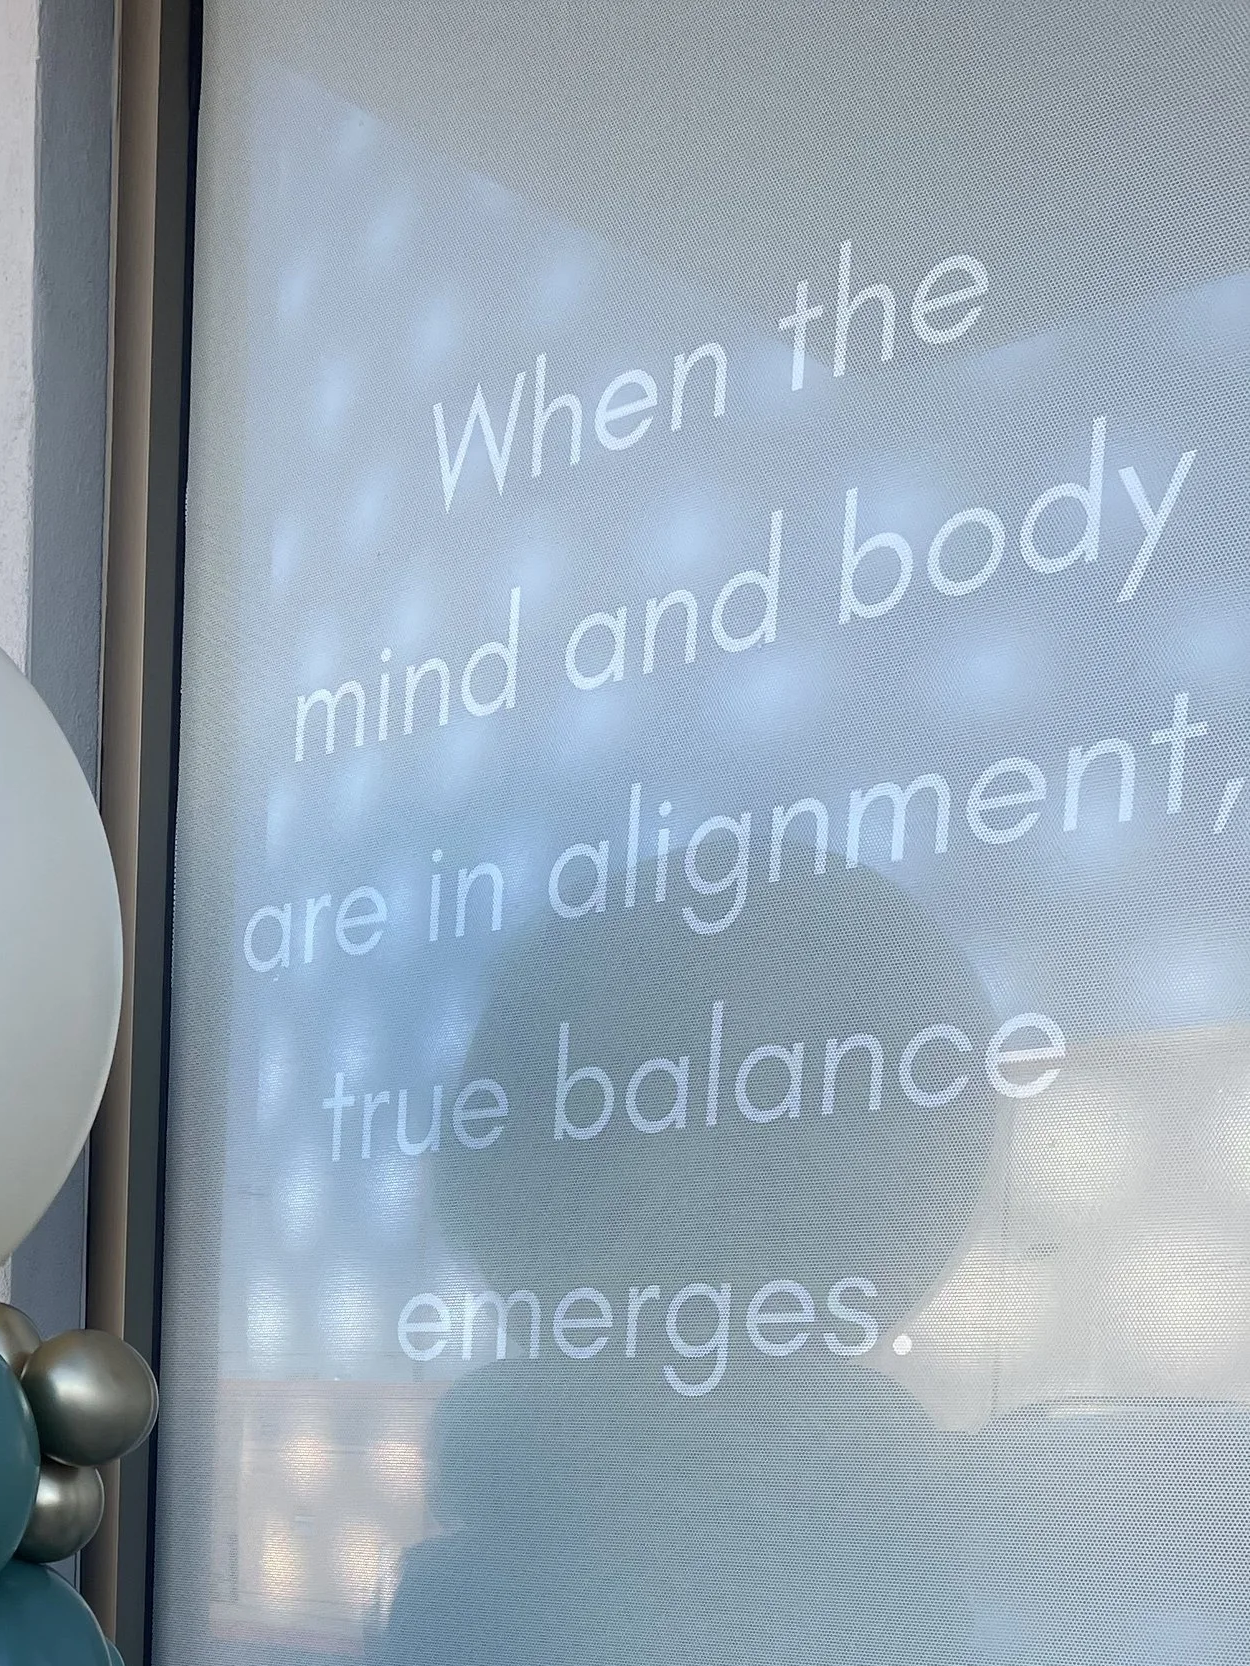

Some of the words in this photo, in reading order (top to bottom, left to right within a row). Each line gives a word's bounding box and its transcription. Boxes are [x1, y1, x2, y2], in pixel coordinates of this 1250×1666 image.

[432, 340, 728, 513] When
[777, 238, 990, 392] the
[293, 585, 521, 763] mind
[563, 508, 785, 691] and
[837, 414, 1198, 626] body
[242, 884, 387, 974] are
[426, 847, 505, 943] in
[547, 691, 1246, 935] alignment,
[320, 1070, 511, 1163] true
[551, 999, 1067, 1142] balance
[396, 1275, 913, 1397] emerges.
